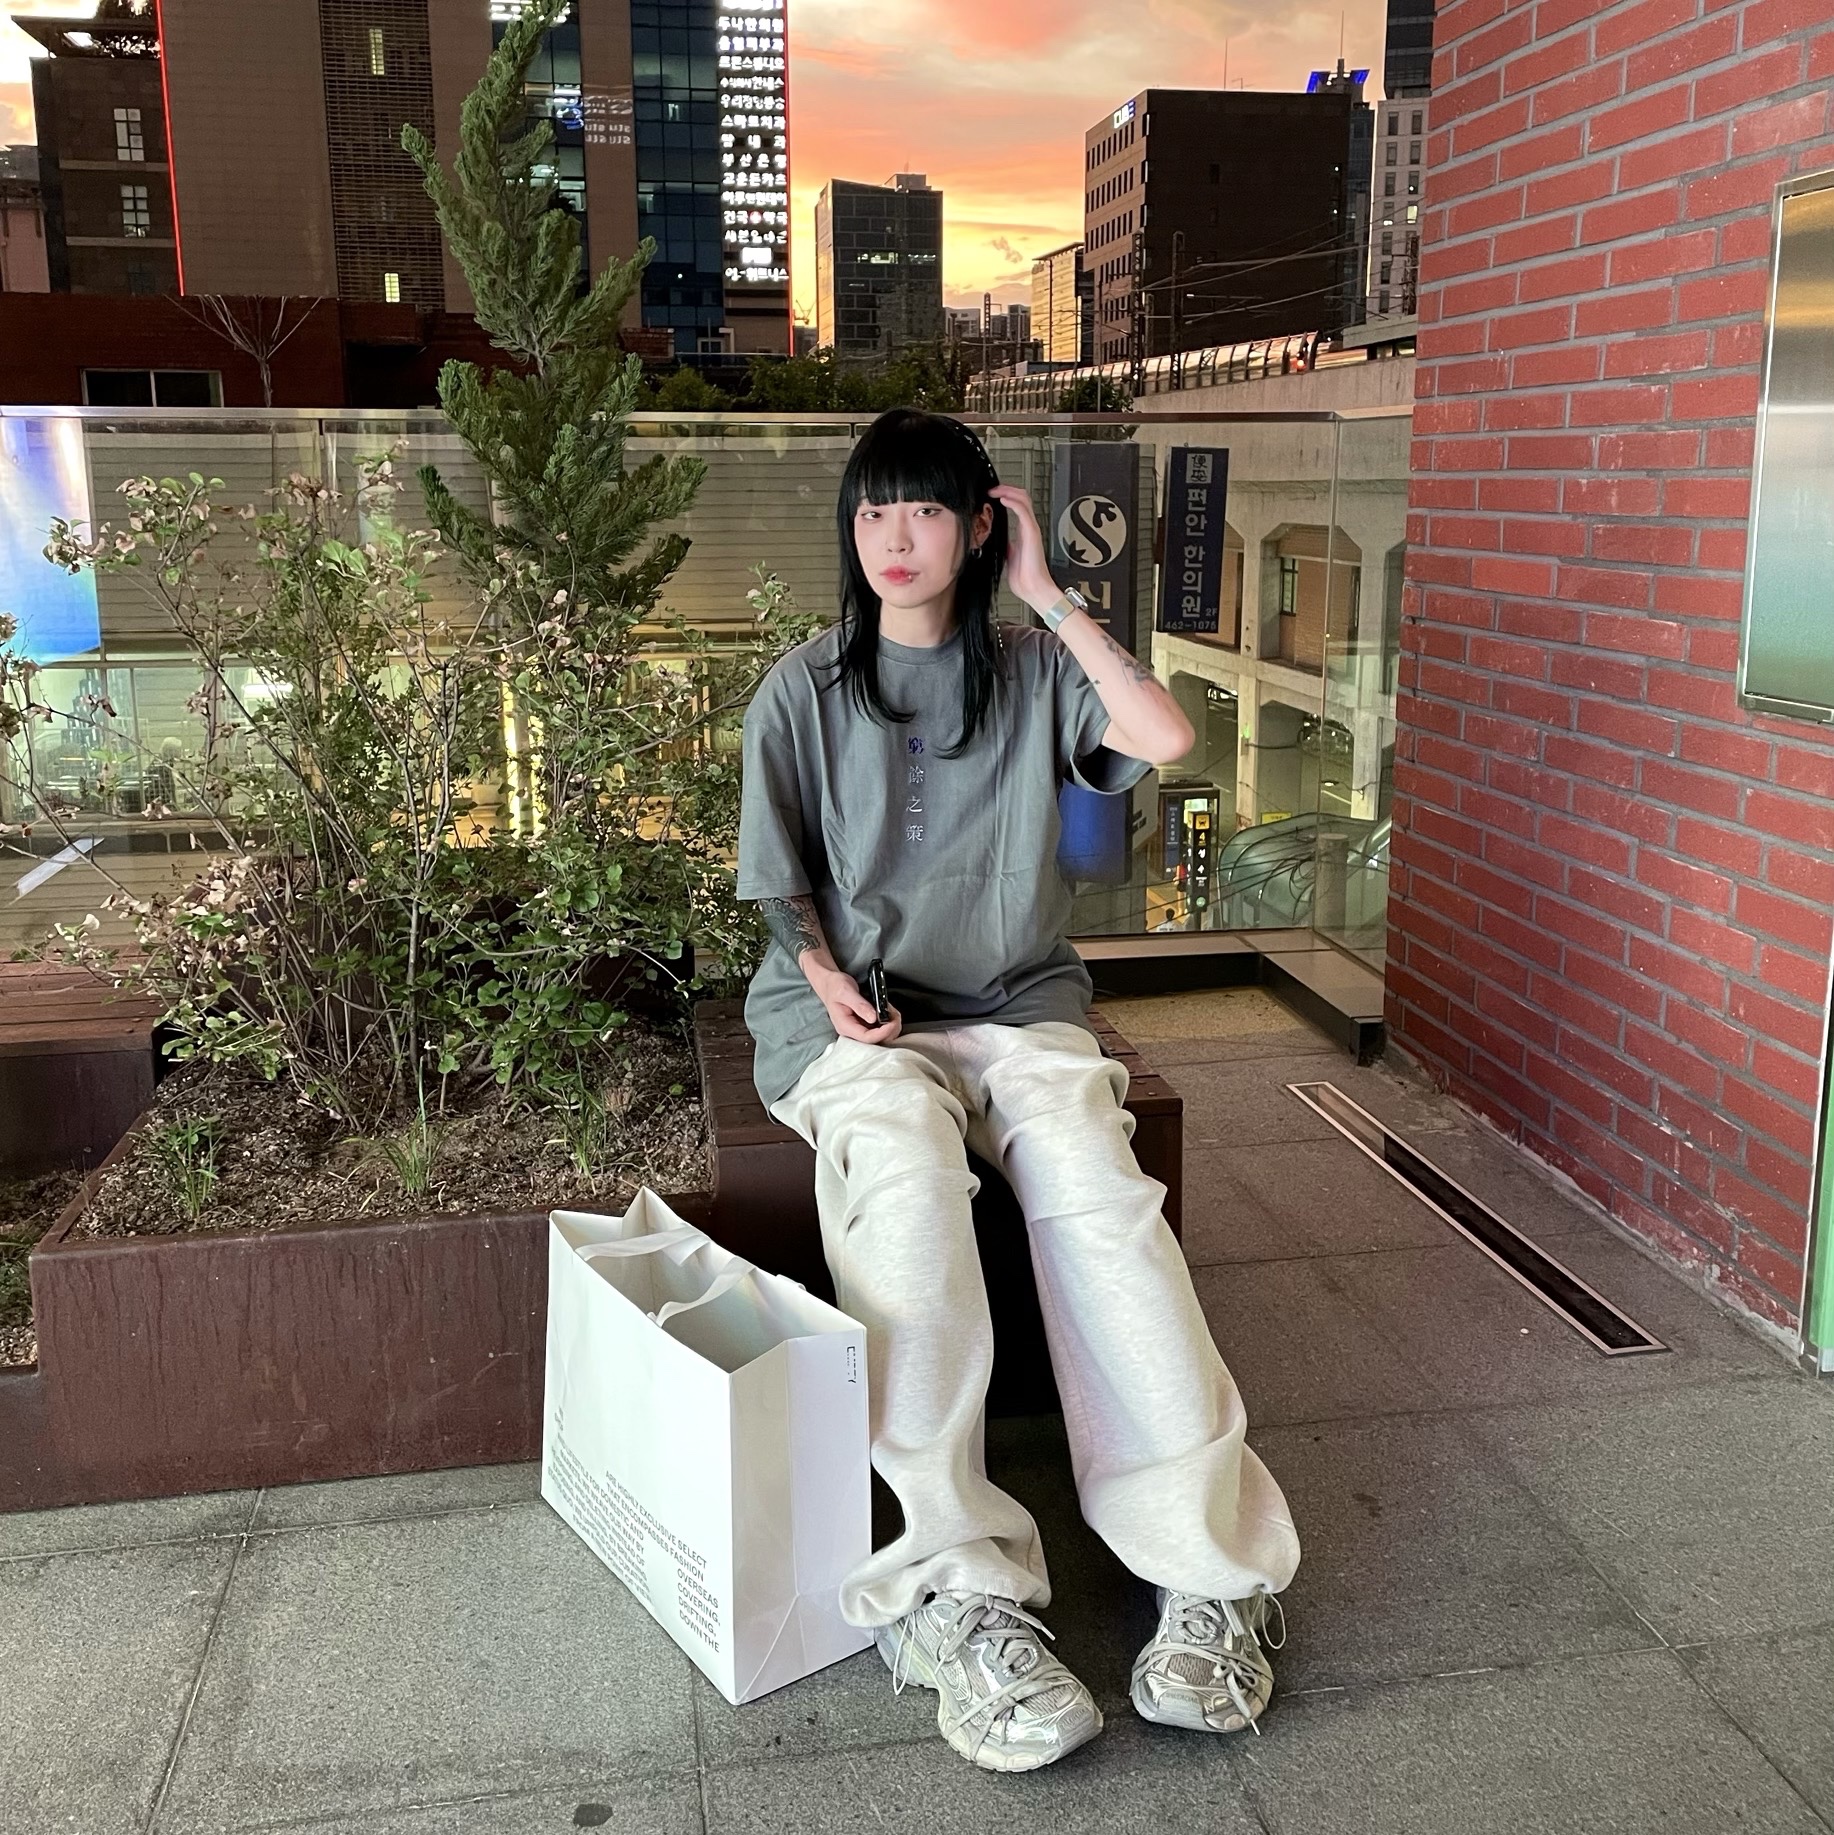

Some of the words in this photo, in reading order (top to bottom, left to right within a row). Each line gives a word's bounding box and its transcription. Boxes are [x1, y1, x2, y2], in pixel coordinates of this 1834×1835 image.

[1185, 488, 1208, 537] 편안
[1182, 544, 1206, 618] 한의원
[621, 1500, 668, 1553] ENCOMPASSES
[670, 1548, 703, 1582] FASHION
[629, 1522, 643, 1542] AND
[677, 1568, 718, 1610] OVERSEAS
[639, 1505, 676, 1546] EXCLUSIVE
[677, 1539, 706, 1570] SELECT
[677, 1582, 720, 1627] COVERING,
[678, 1597, 716, 1638] DRIFTING,
[679, 1610, 702, 1639] DOWN
[703, 1633, 719, 1654] THE
